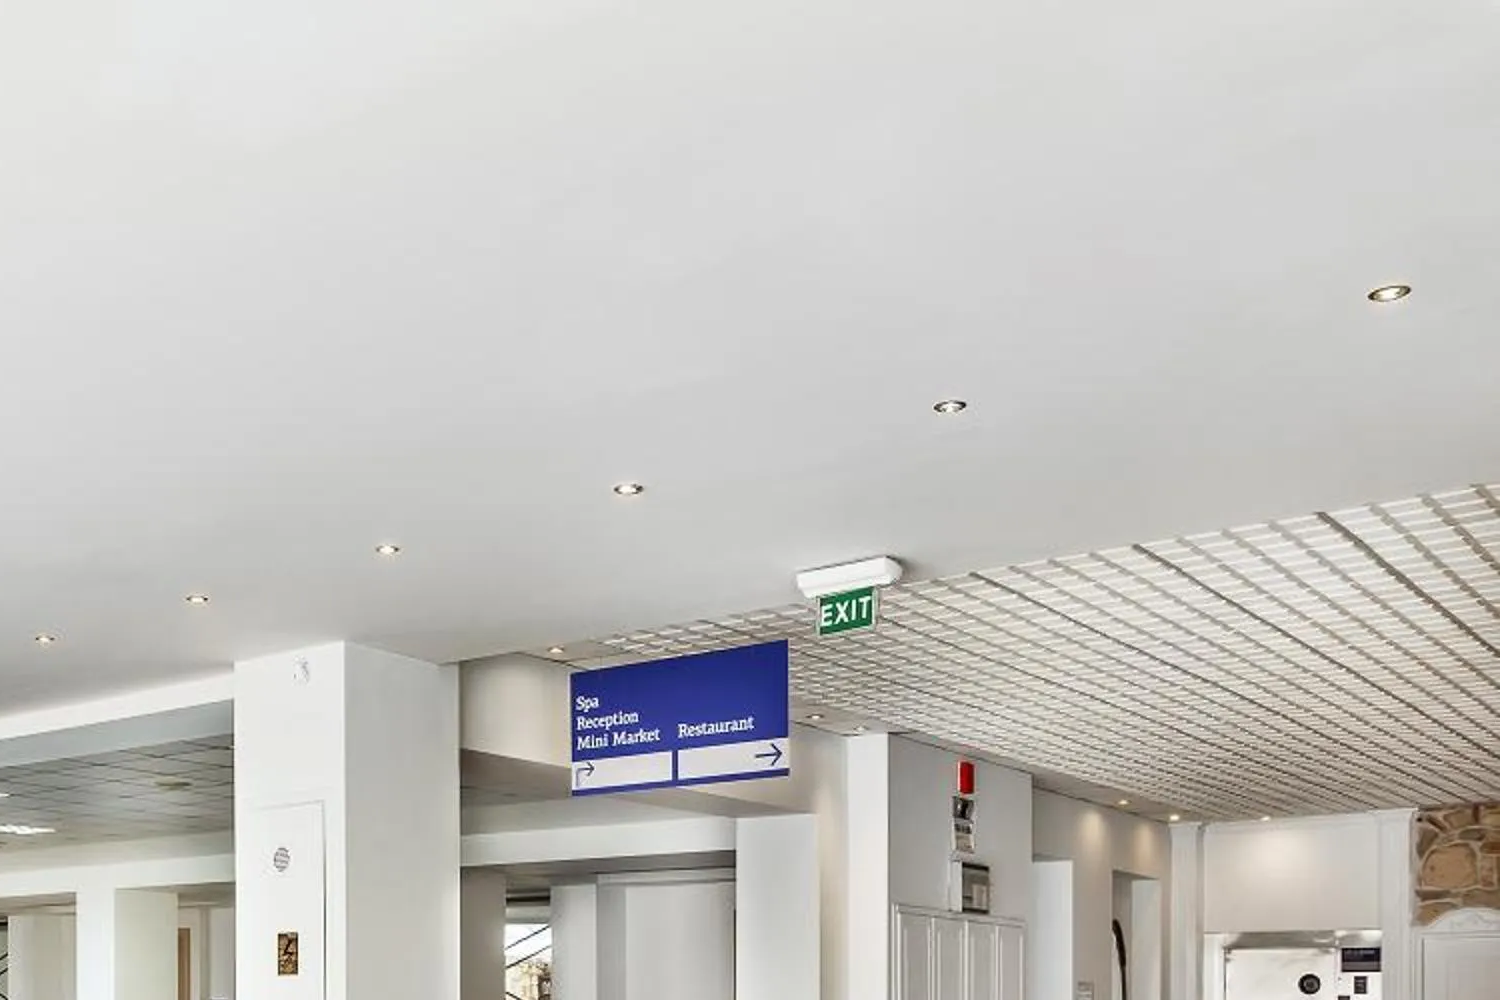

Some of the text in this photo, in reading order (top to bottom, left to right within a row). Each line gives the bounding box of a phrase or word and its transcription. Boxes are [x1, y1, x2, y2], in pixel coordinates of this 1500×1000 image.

[821, 596, 871, 626] EXIT
[576, 696, 599, 712] Spa
[577, 711, 639, 730] Reception
[678, 716, 755, 738] Restaurant
[577, 728, 660, 750] Mini Market
